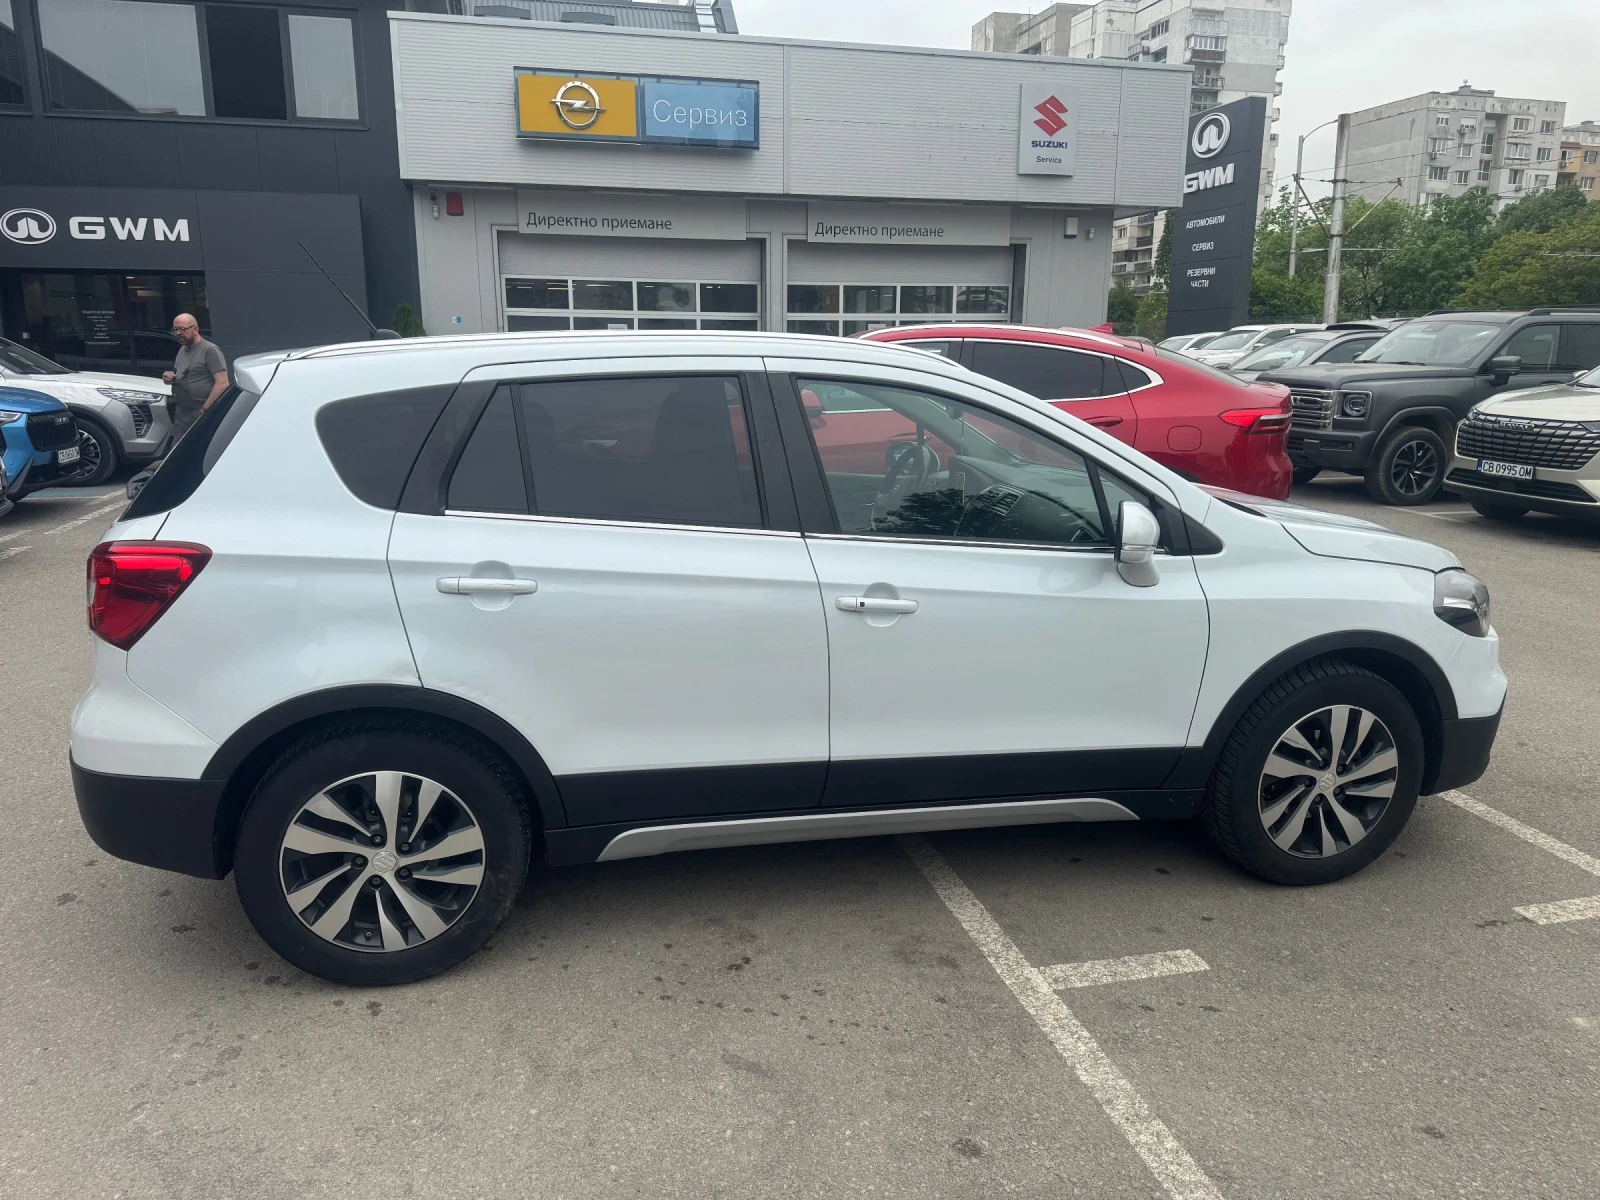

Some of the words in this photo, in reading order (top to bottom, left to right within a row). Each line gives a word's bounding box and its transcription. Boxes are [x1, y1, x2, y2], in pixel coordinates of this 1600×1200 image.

[653, 99, 748, 129] Сервиз
[1031, 140, 1068, 149] SUZUKI
[1036, 155, 1063, 164] Service
[1183, 163, 1235, 194] GWM
[69, 216, 190, 242] GWM
[526, 212, 598, 229] Директно
[602, 216, 673, 231] приемане
[1186, 215, 1226, 230] АВТОМОБИЛИ
[814, 222, 878, 238] Директно
[881, 225, 945, 239] приемане
[1192, 241, 1215, 252] СЕРВИЗ
[1187, 266, 1216, 278] РЕЗЕРВНИ
[1191, 279, 1210, 288] ЧАСТИ
[1482, 461, 1494, 473] CB
[1495, 462, 1518, 476] 0995
